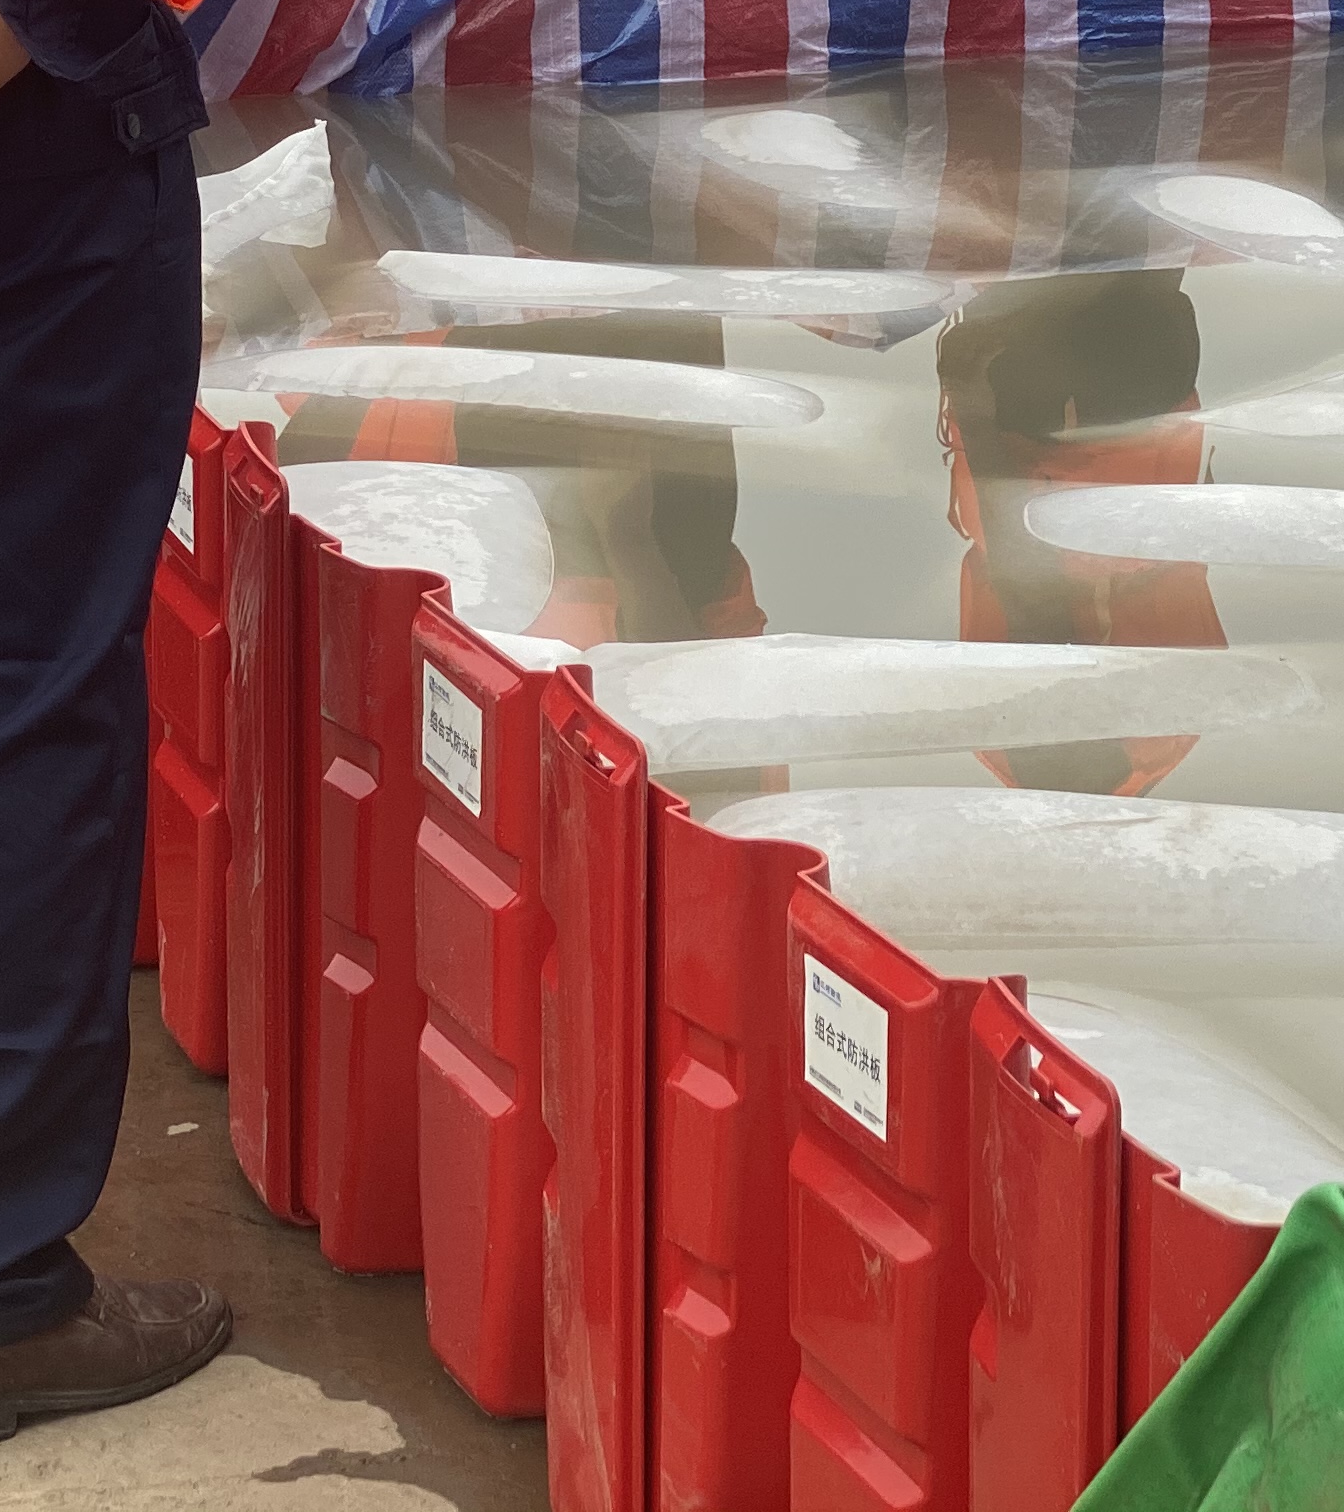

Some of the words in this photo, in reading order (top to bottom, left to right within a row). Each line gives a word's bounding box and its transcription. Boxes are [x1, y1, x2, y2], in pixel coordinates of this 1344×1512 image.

[429, 708, 478, 770] 组合式防洪板
[814, 1012, 881, 1085] 组合式防洪板
